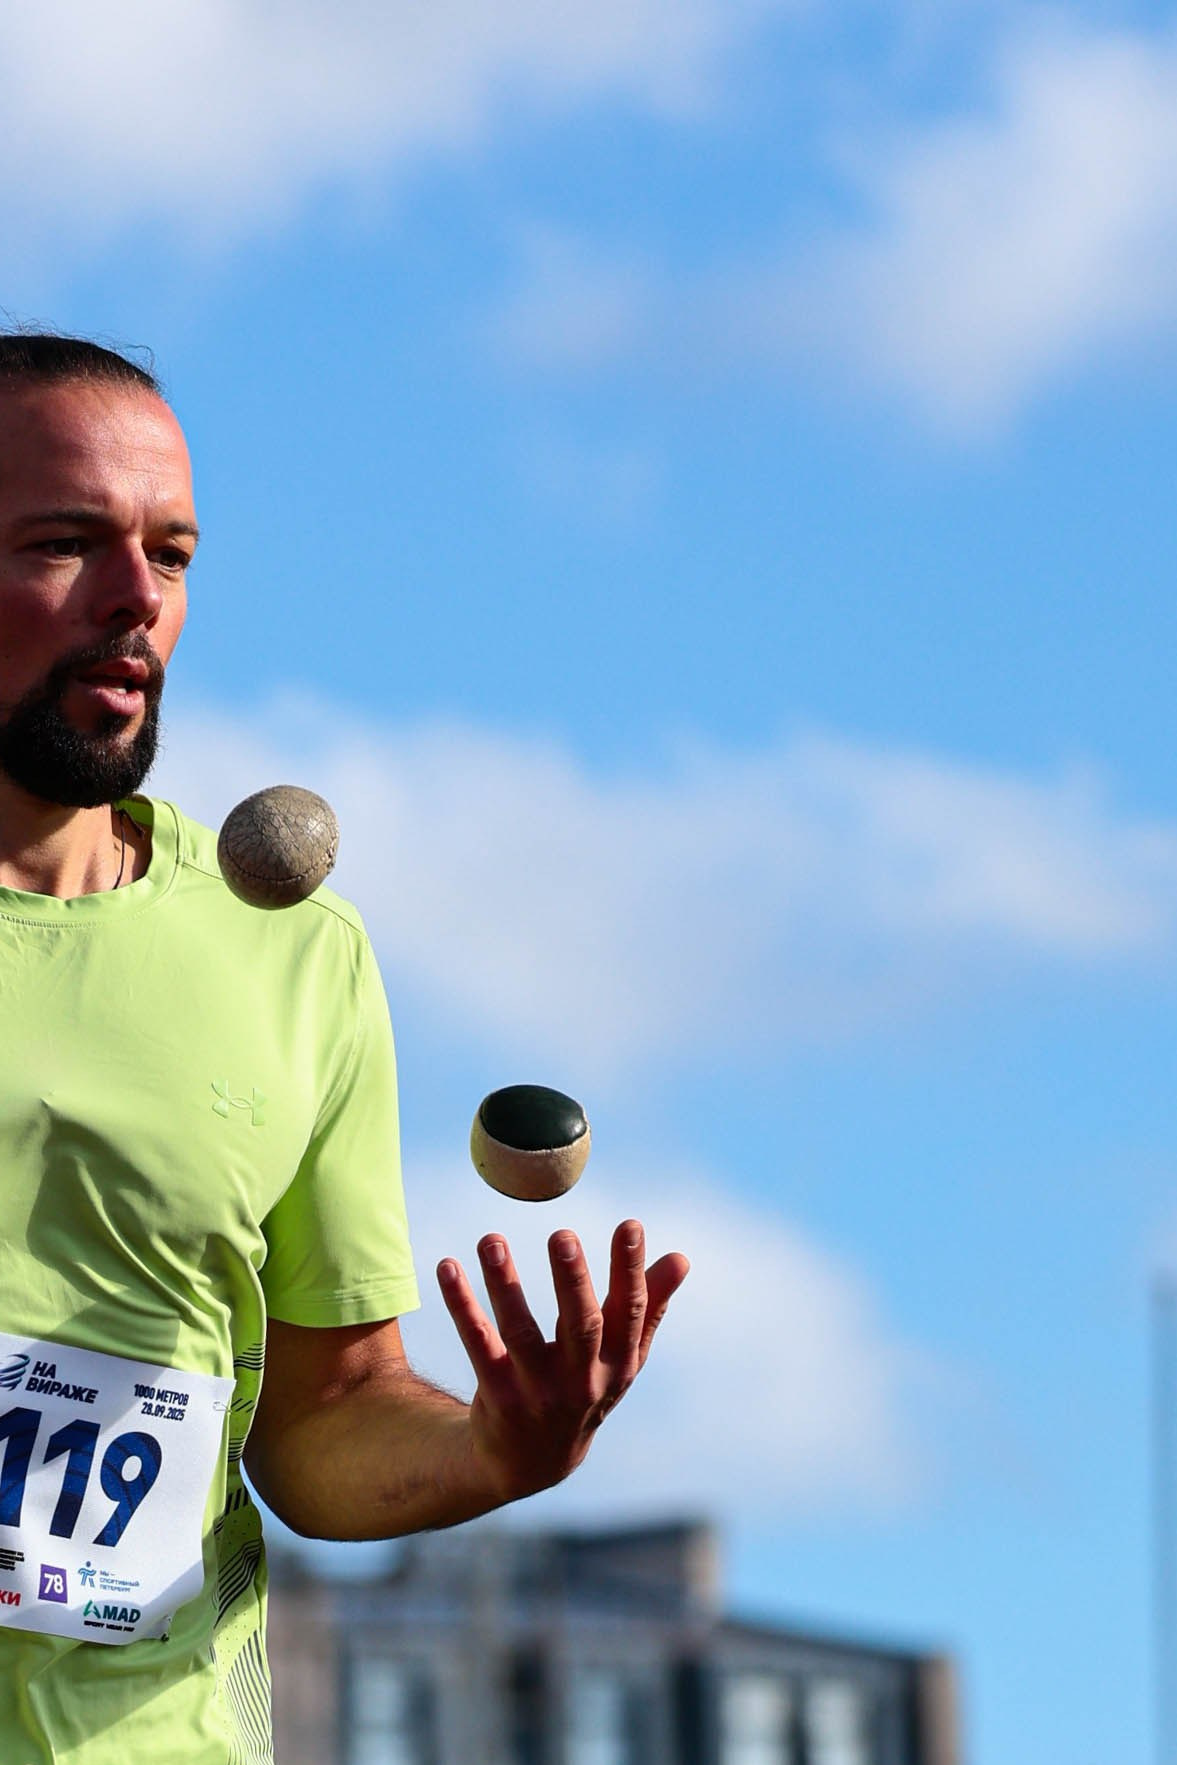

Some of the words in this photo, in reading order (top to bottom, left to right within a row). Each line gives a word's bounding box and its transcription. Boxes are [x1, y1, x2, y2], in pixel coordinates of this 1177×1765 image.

[32, 1361, 56, 1379] НА
[25, 1377, 99, 1404] ВИРАЖЕ
[134, 1384, 155, 1399] 1000
[156, 1388, 189, 1406] МЕТРОВ
[141, 1402, 186, 1421] 28.09.2025
[43, 1573, 64, 1594] 78
